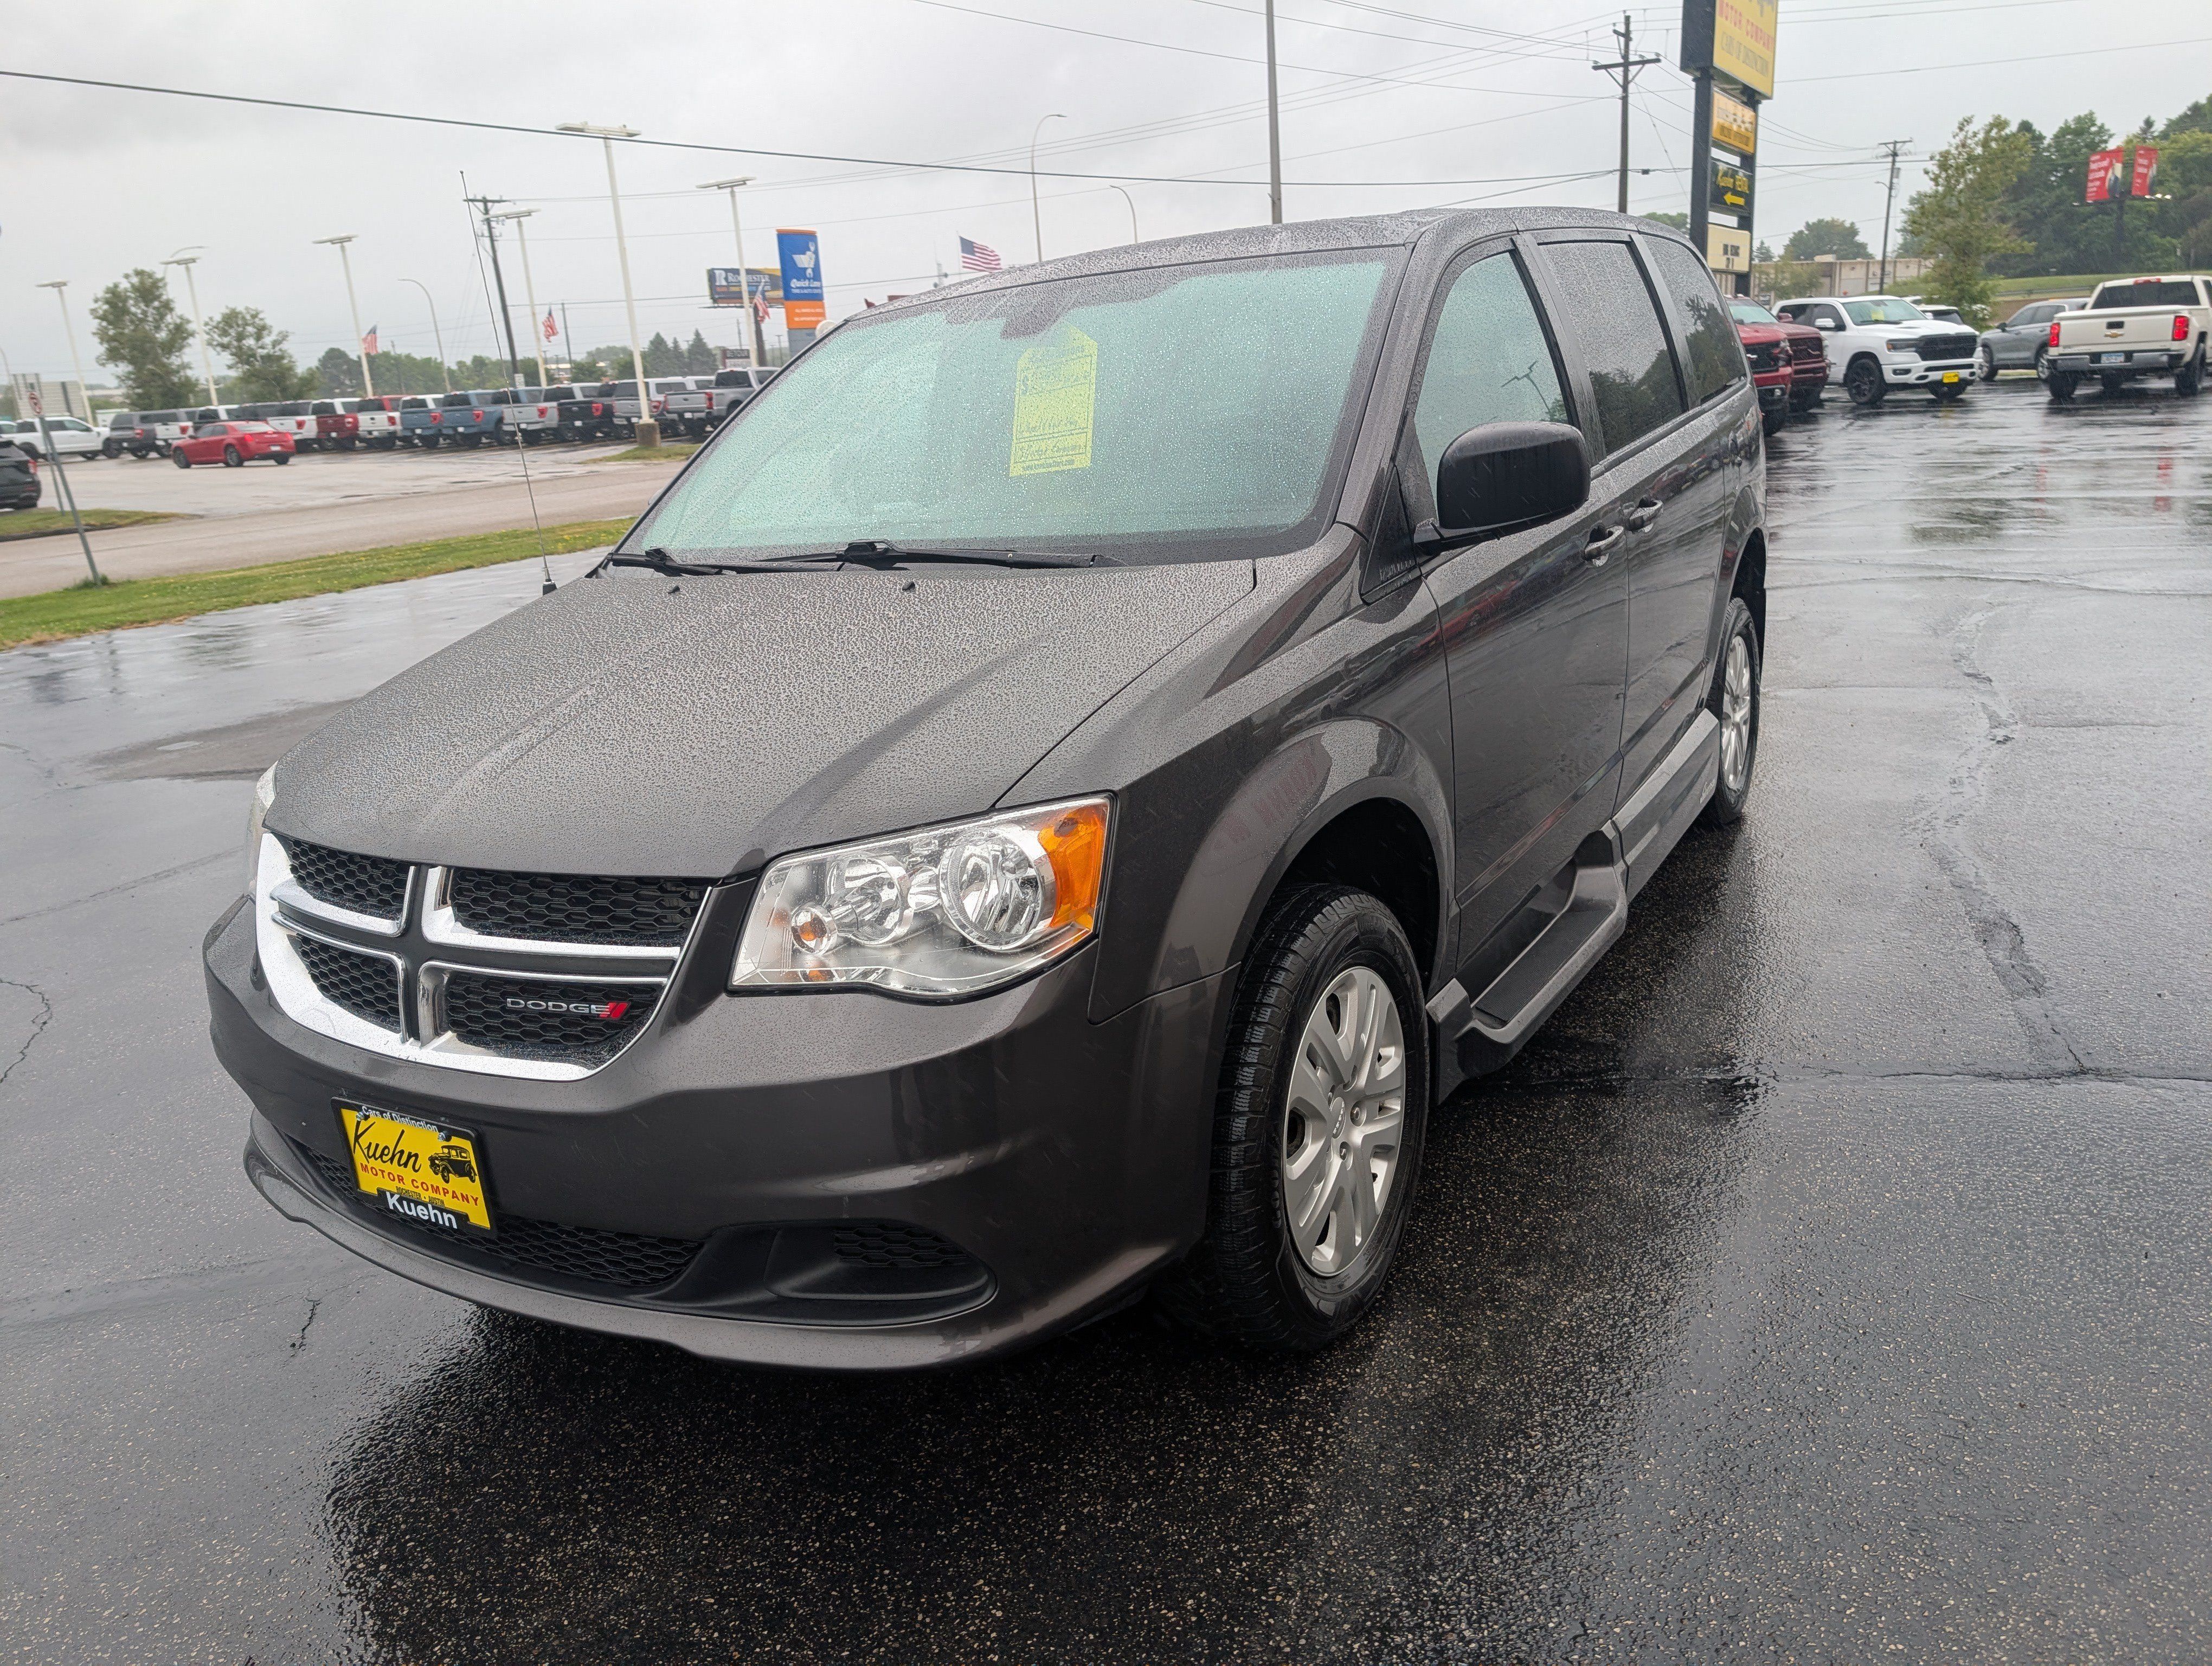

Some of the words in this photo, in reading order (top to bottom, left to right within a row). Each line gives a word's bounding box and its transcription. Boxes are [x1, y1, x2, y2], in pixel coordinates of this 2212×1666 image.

[507, 998, 610, 1015] DODGE
[362, 1105, 382, 1118] Cars
[383, 1112, 391, 1120] of
[393, 1113, 439, 1132] Distinction
[352, 1120, 422, 1173] Kuehn
[360, 1162, 406, 1186] MOTOR
[410, 1178, 479, 1207] COMPANY
[396, 1186, 422, 1200] ROCHESTER
[428, 1195, 445, 1207] AUSTIN
[386, 1191, 458, 1229] Kuehn
